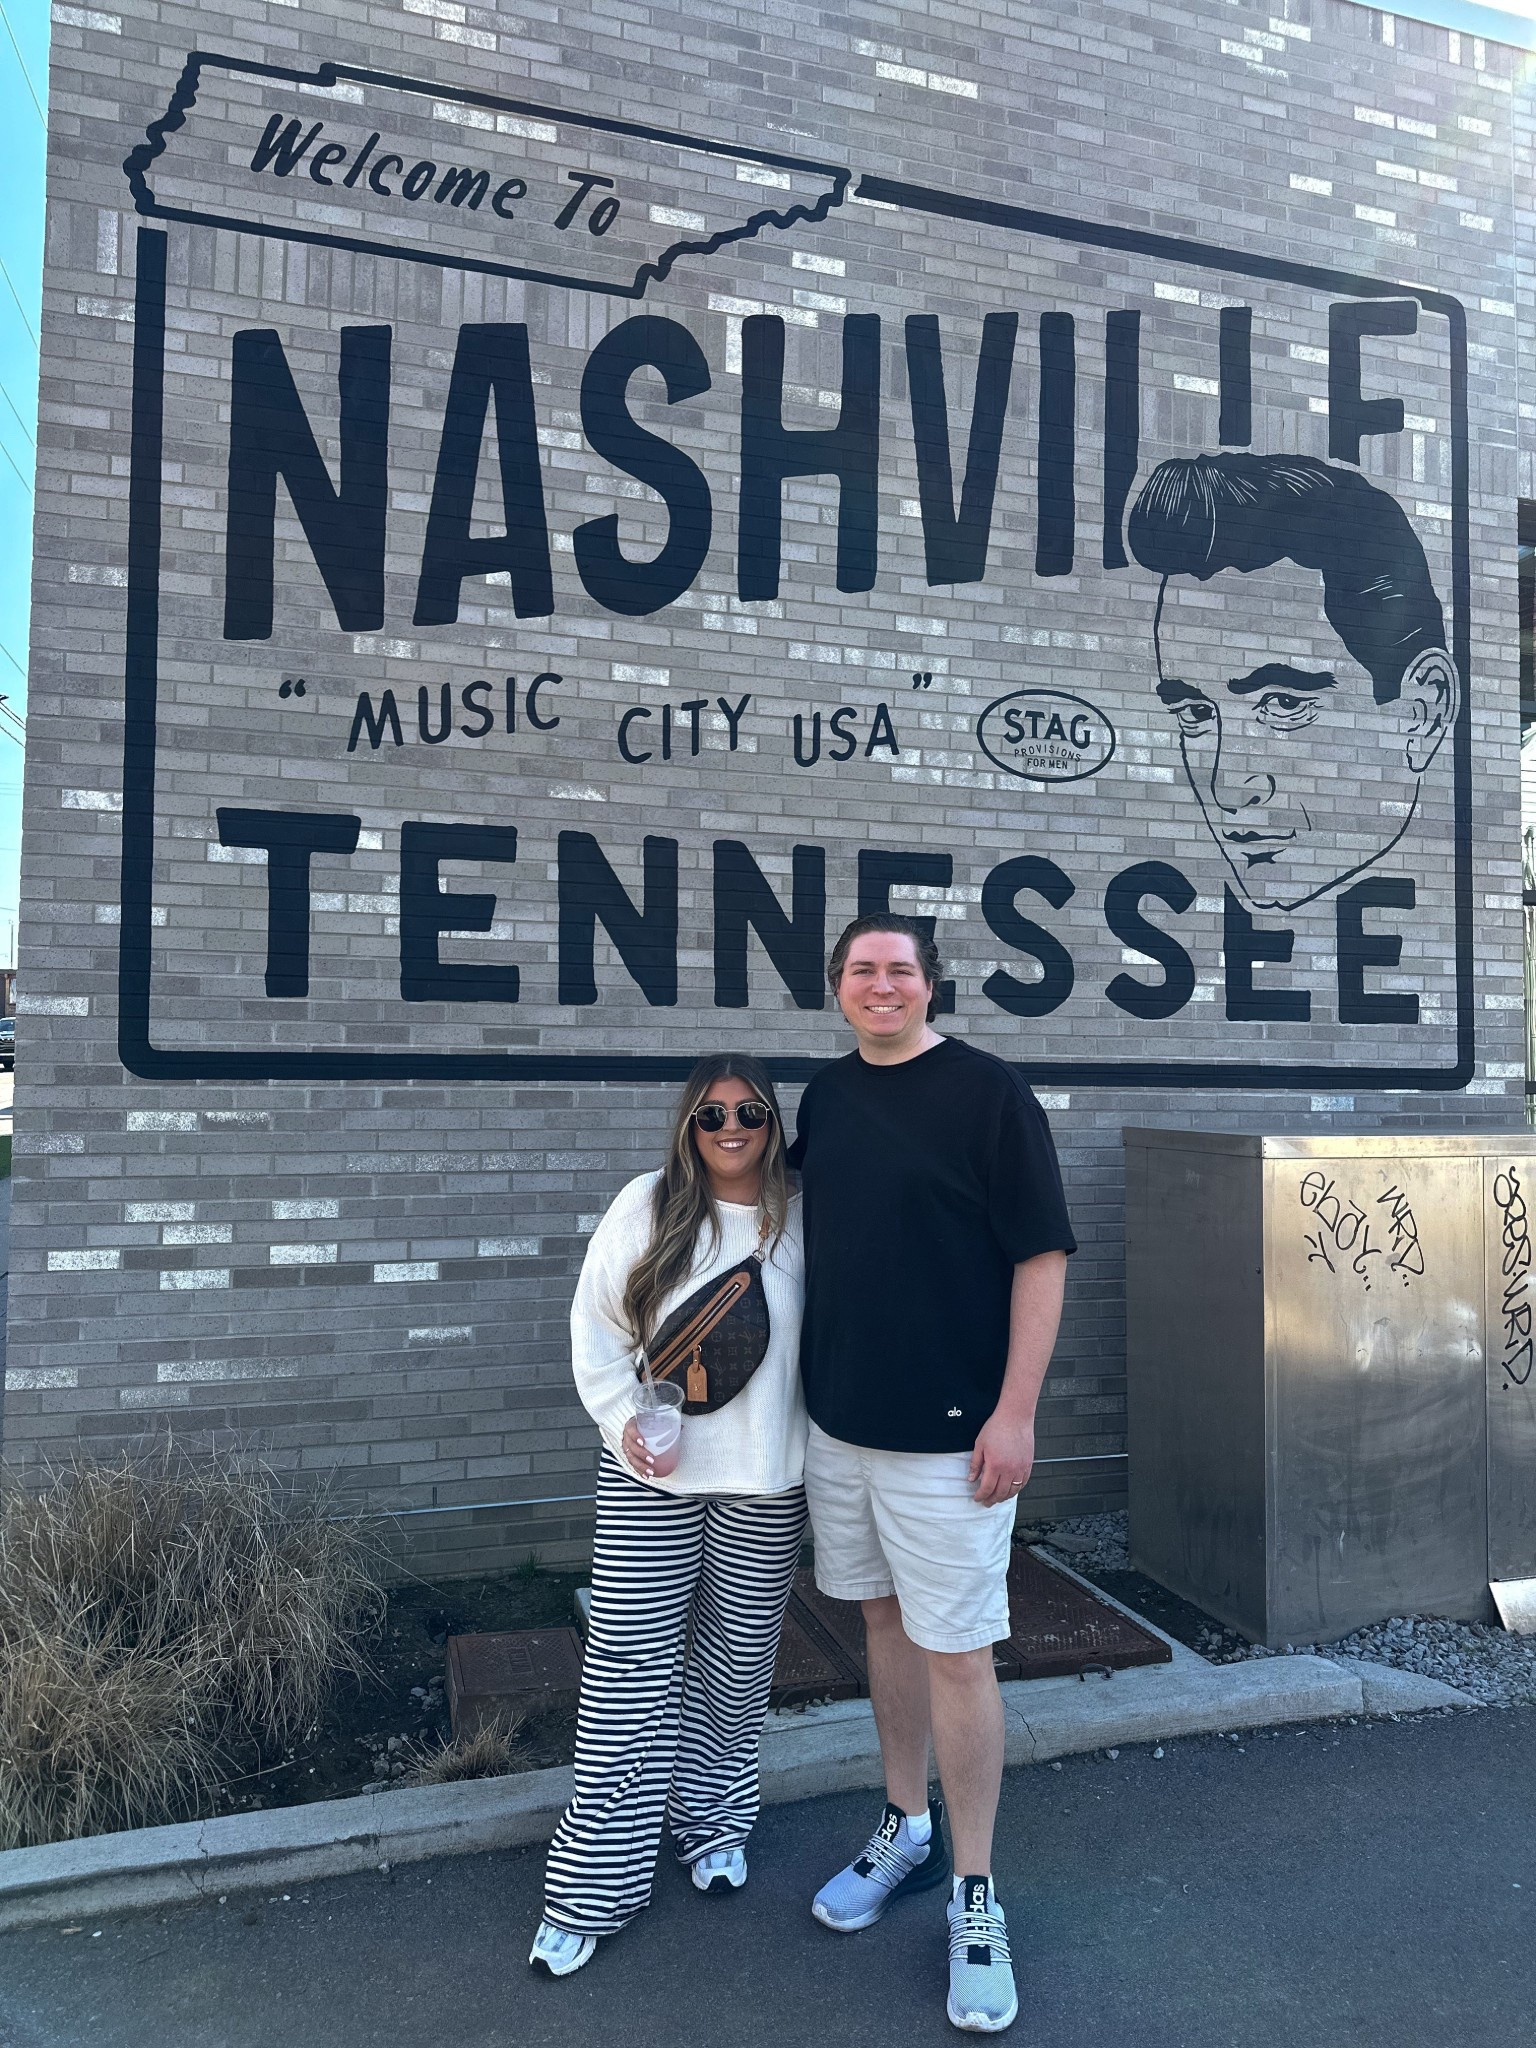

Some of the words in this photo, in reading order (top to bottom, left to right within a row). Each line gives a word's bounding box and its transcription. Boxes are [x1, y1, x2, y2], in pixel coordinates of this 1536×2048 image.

[250, 113, 527, 220] Welcome
[554, 171, 620, 237] To
[618, 694, 752, 764] CITY
[1003, 708, 1092, 750] STAG
[1014, 744, 1082, 763] PROVISIONS
[1026, 757, 1046, 768] FOR
[1048, 759, 1068, 770] MEN
[215, 806, 1420, 1025] TENNESSEE
